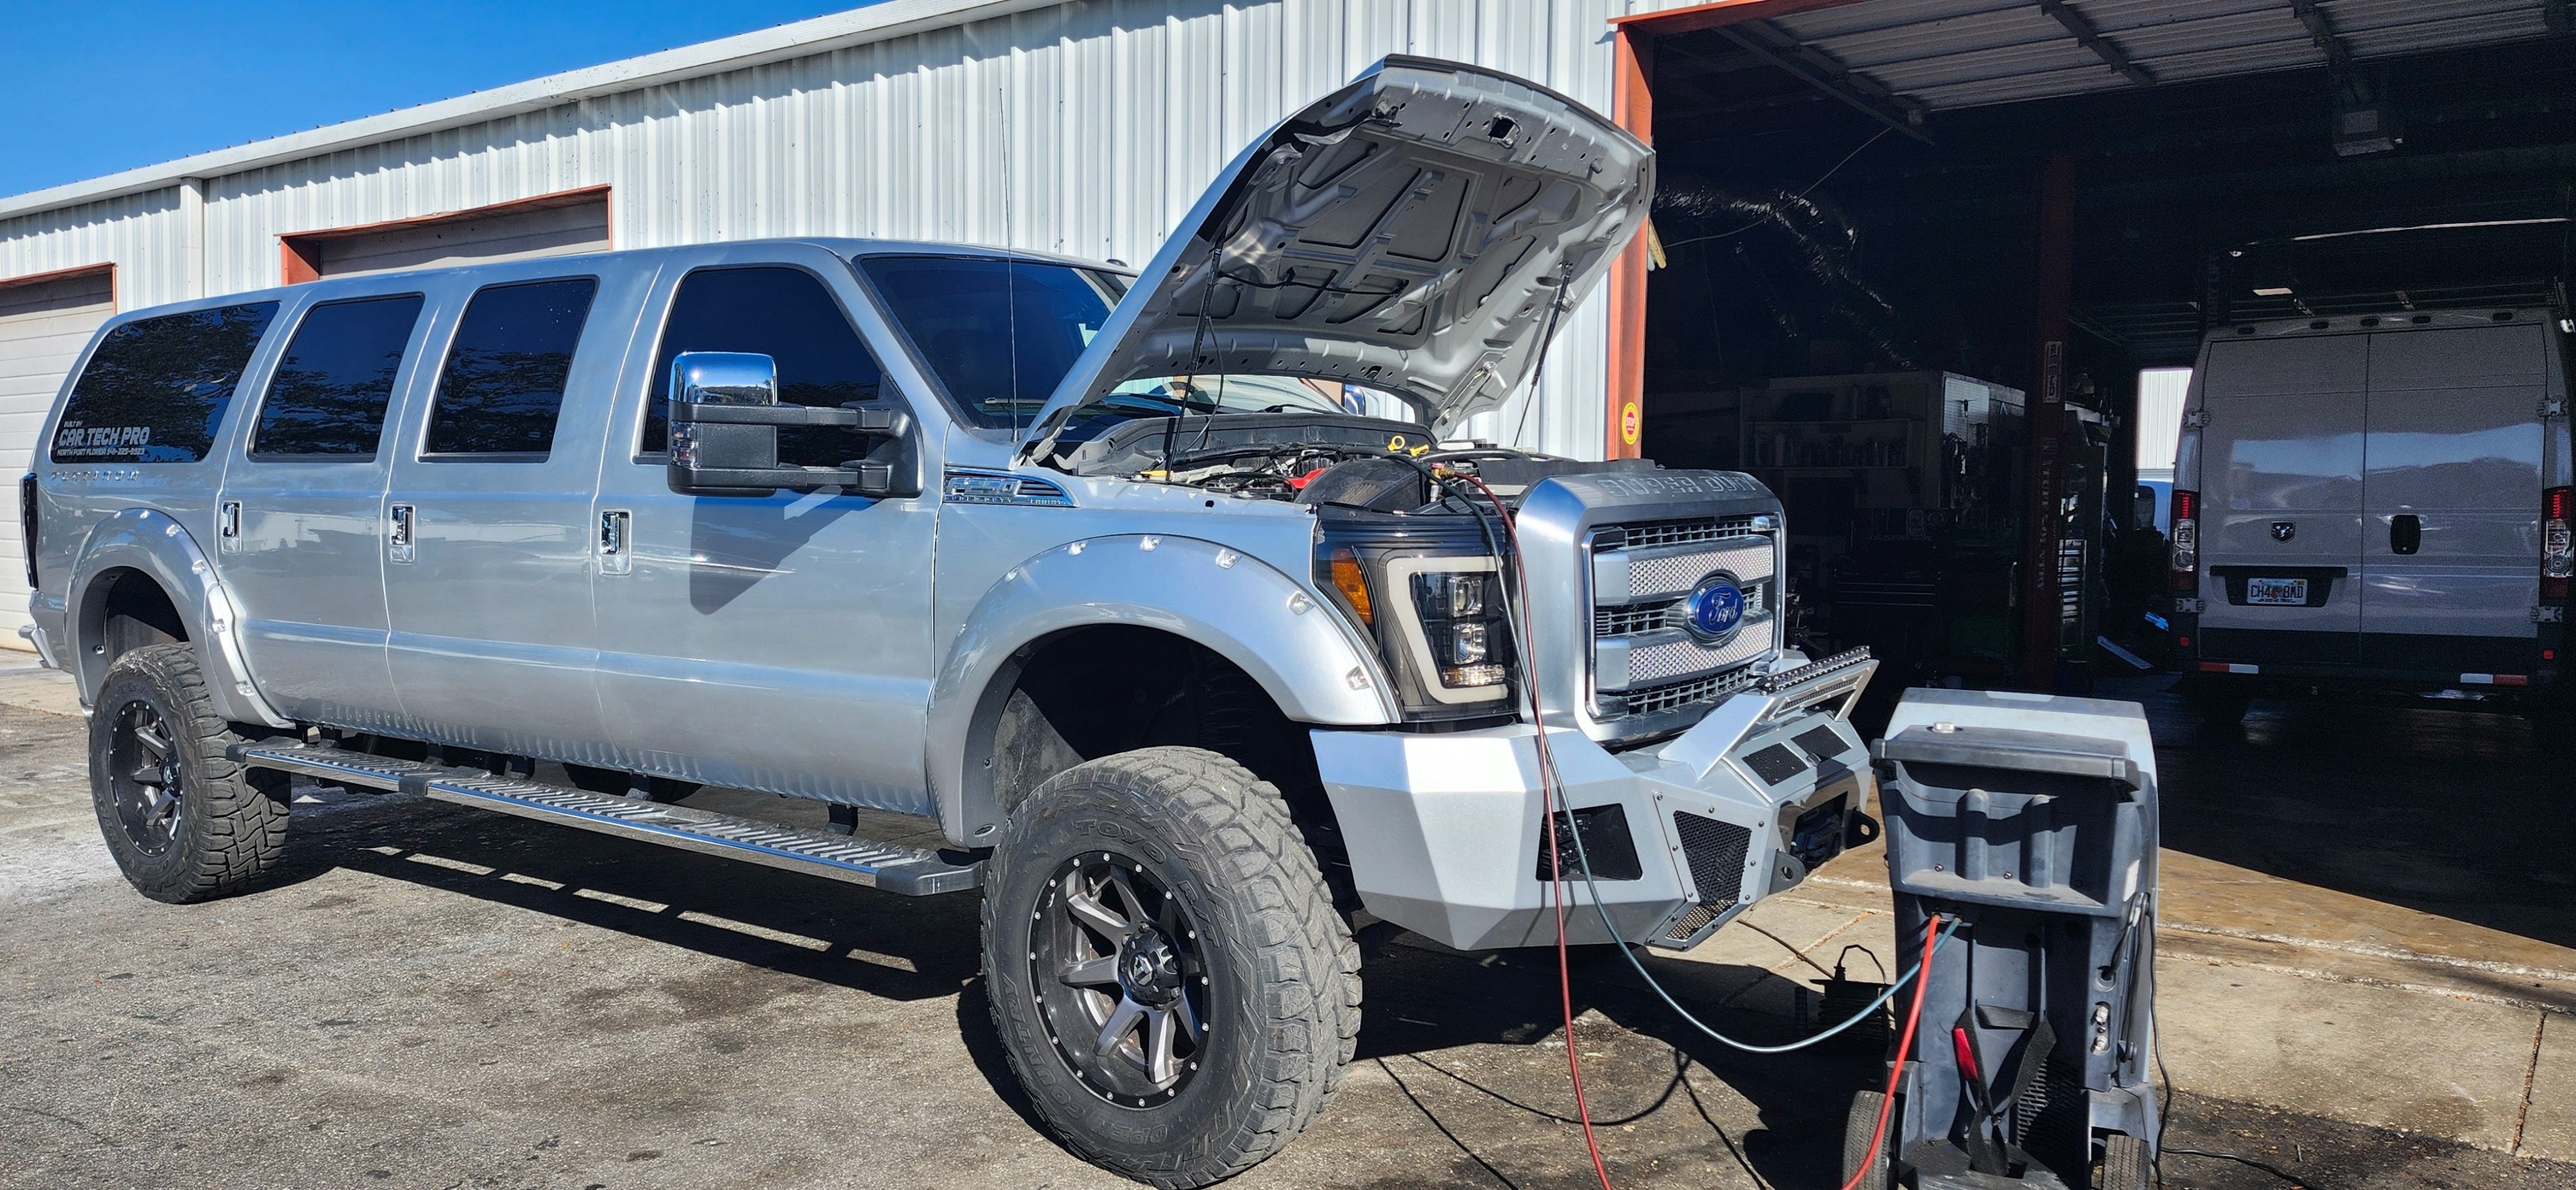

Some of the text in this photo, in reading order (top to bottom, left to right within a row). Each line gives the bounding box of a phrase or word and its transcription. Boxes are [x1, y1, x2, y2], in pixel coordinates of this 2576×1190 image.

[58, 427, 150, 446] CAR TECH PRO
[50, 470, 140, 481] PLATINUM
[1595, 475, 1757, 498] SUPER DUTY
[2250, 585, 2271, 598] CH4
[1708, 592, 1738, 625] Ford
[1071, 819, 1167, 864] TOYO
[1002, 972, 1086, 1121] COUNTRY
[1088, 1120, 1168, 1145] OPEN
